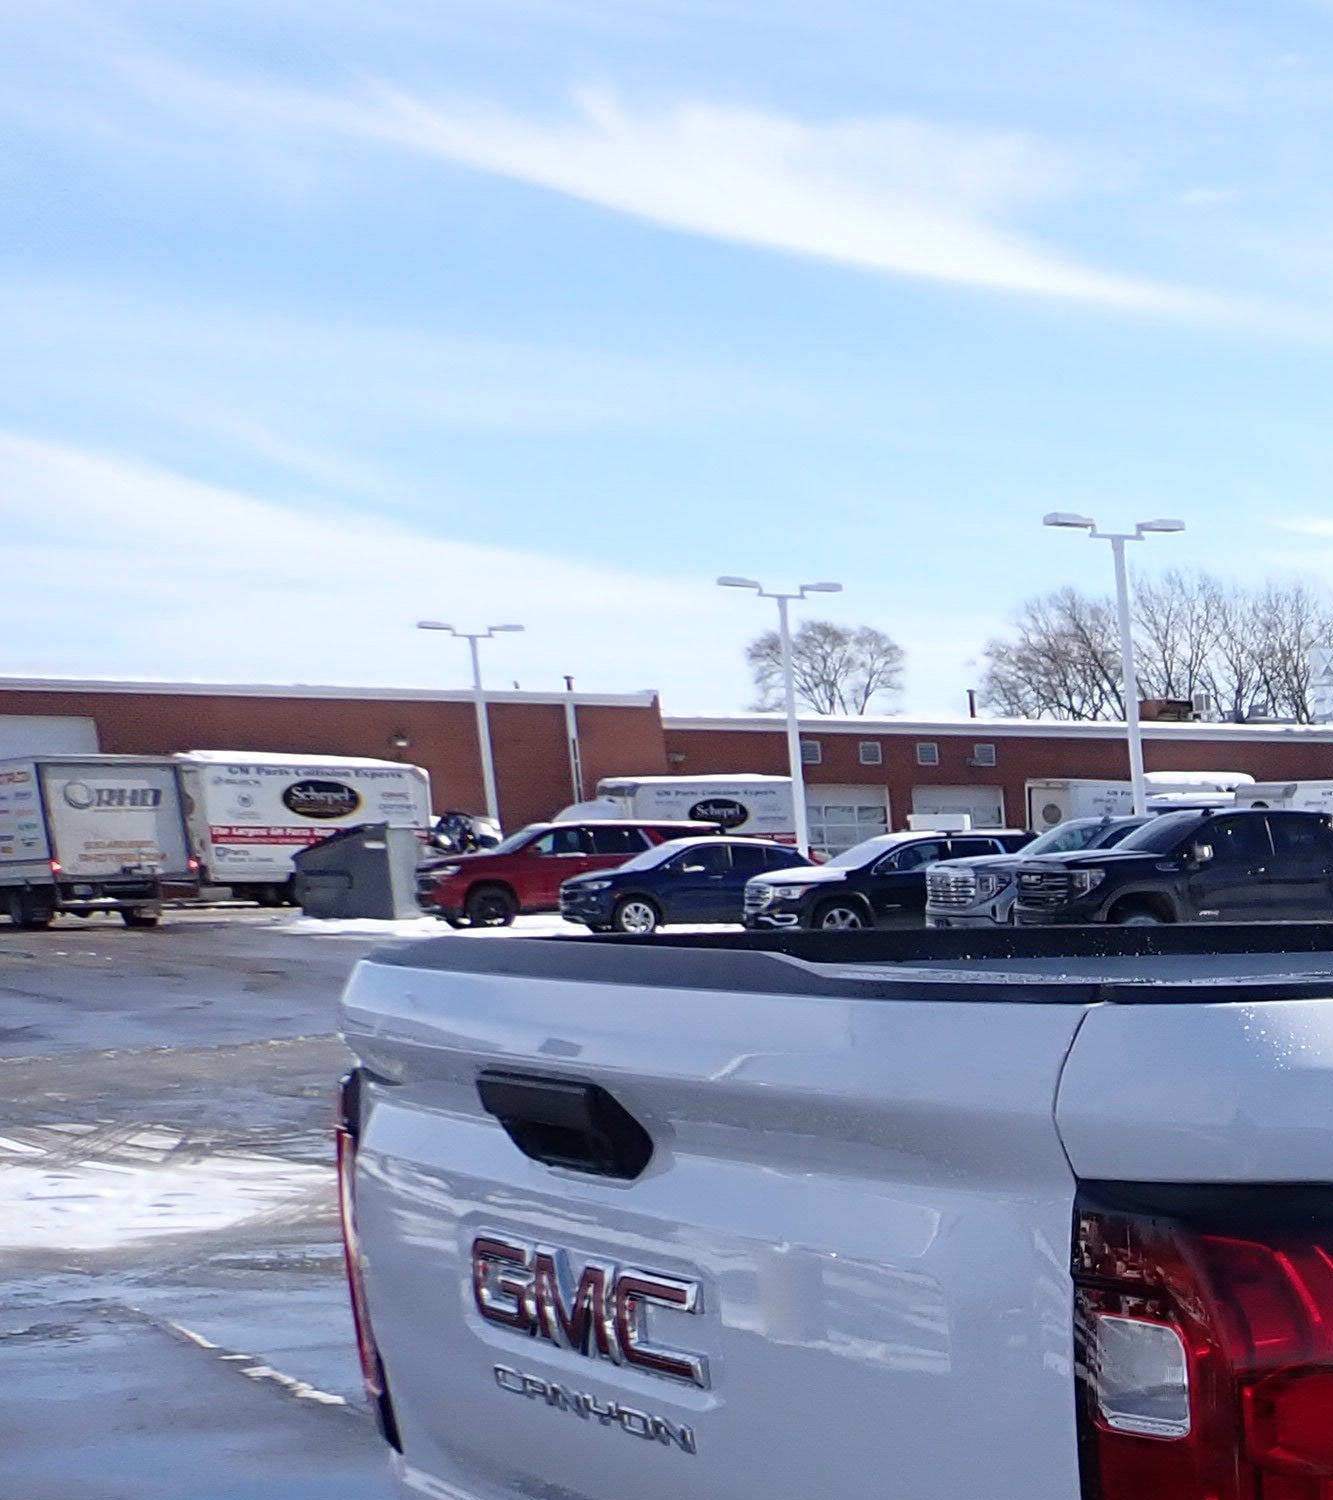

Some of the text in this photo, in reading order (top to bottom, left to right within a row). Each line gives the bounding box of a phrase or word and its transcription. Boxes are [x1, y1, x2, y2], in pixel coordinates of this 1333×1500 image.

[294, 768, 351, 778] Collision
[355, 770, 403, 780] Experts
[695, 803, 741, 819] Schepel
[472, 1234, 712, 1391] GMC
[493, 1362, 698, 1455] CANYON
